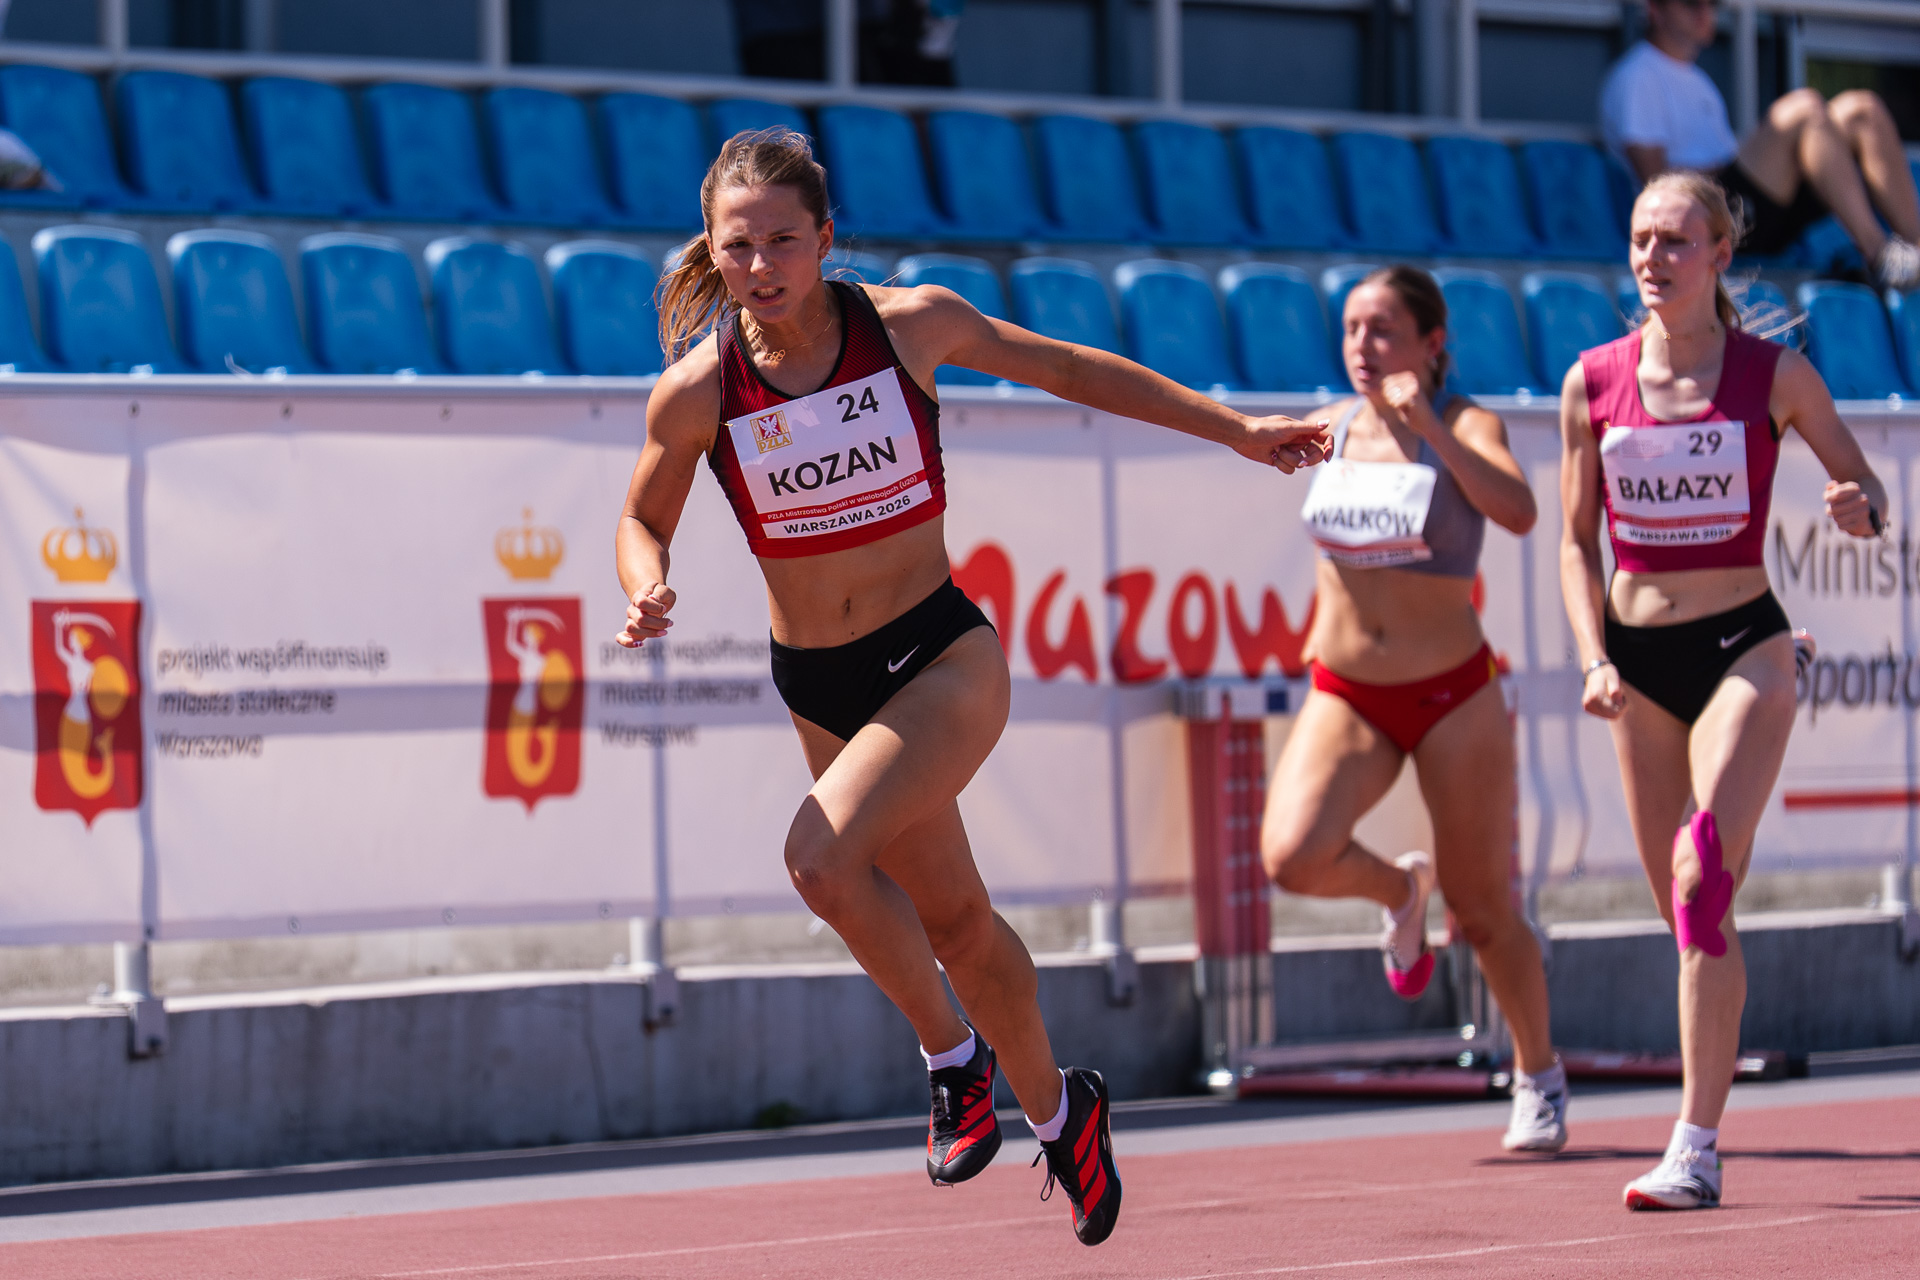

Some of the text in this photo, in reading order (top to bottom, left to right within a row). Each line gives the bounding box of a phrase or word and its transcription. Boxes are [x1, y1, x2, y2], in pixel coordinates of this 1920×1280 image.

[836, 386, 880, 424] 24
[758, 435, 791, 452] PZLA
[1688, 429, 1723, 457] 29
[767, 436, 898, 497] KOZAN
[767, 512, 785, 521] PZLA
[785, 507, 827, 518] Mistrzostwa
[827, 499, 849, 512] Polski
[856, 486, 899, 503] wielobojach
[898, 475, 918, 490] (U20)
[1617, 472, 1734, 504] BAŁAZY
[783, 495, 911, 534] WARSZAWA 2026
[1774, 516, 1920, 598] Minist
